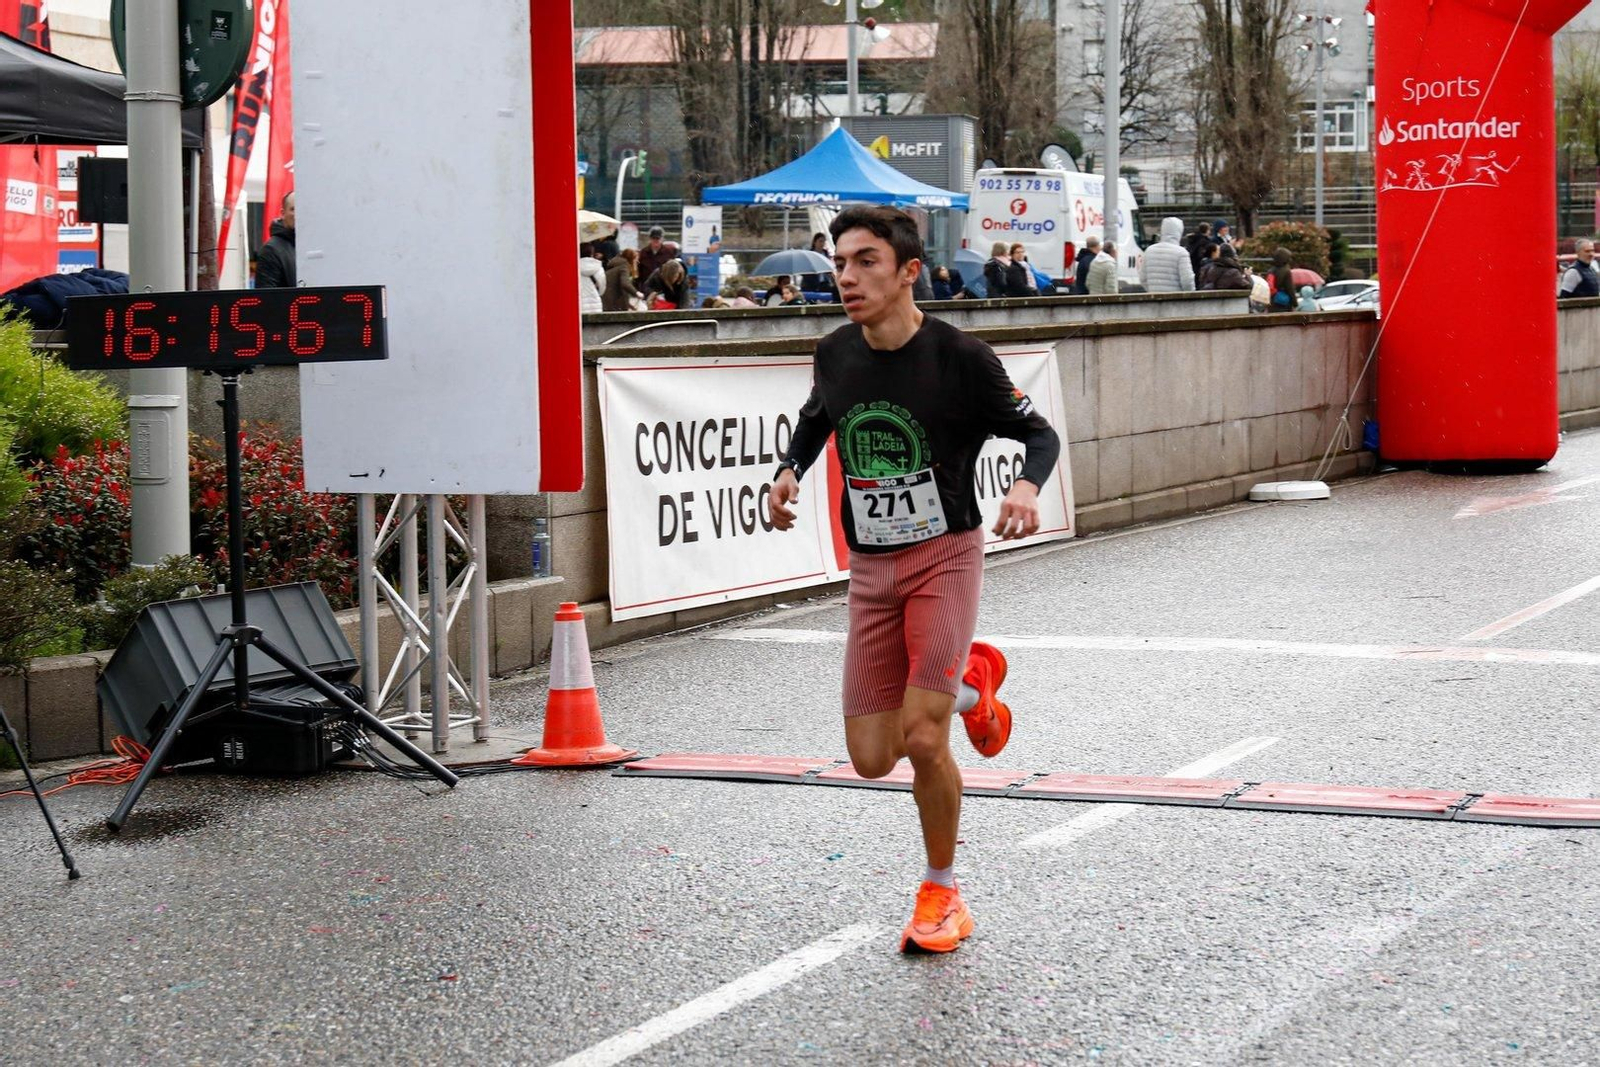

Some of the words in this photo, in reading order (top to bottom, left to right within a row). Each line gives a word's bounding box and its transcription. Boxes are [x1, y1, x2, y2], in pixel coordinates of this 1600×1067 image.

[1402, 76, 1480, 106] Sports
[1397, 116, 1521, 143] Santander
[892, 142, 942, 156] McFIT
[7, 186, 34, 197] ELLO
[980, 179, 1002, 190] 902
[1006, 179, 1021, 190] 55
[1026, 180, 1041, 191] 78
[1046, 180, 1061, 191] 98
[982, 218, 1055, 235] OneFurgO
[635, 413, 792, 476] CONCELLO
[863, 490, 916, 518] 271
[658, 491, 699, 547] DE
